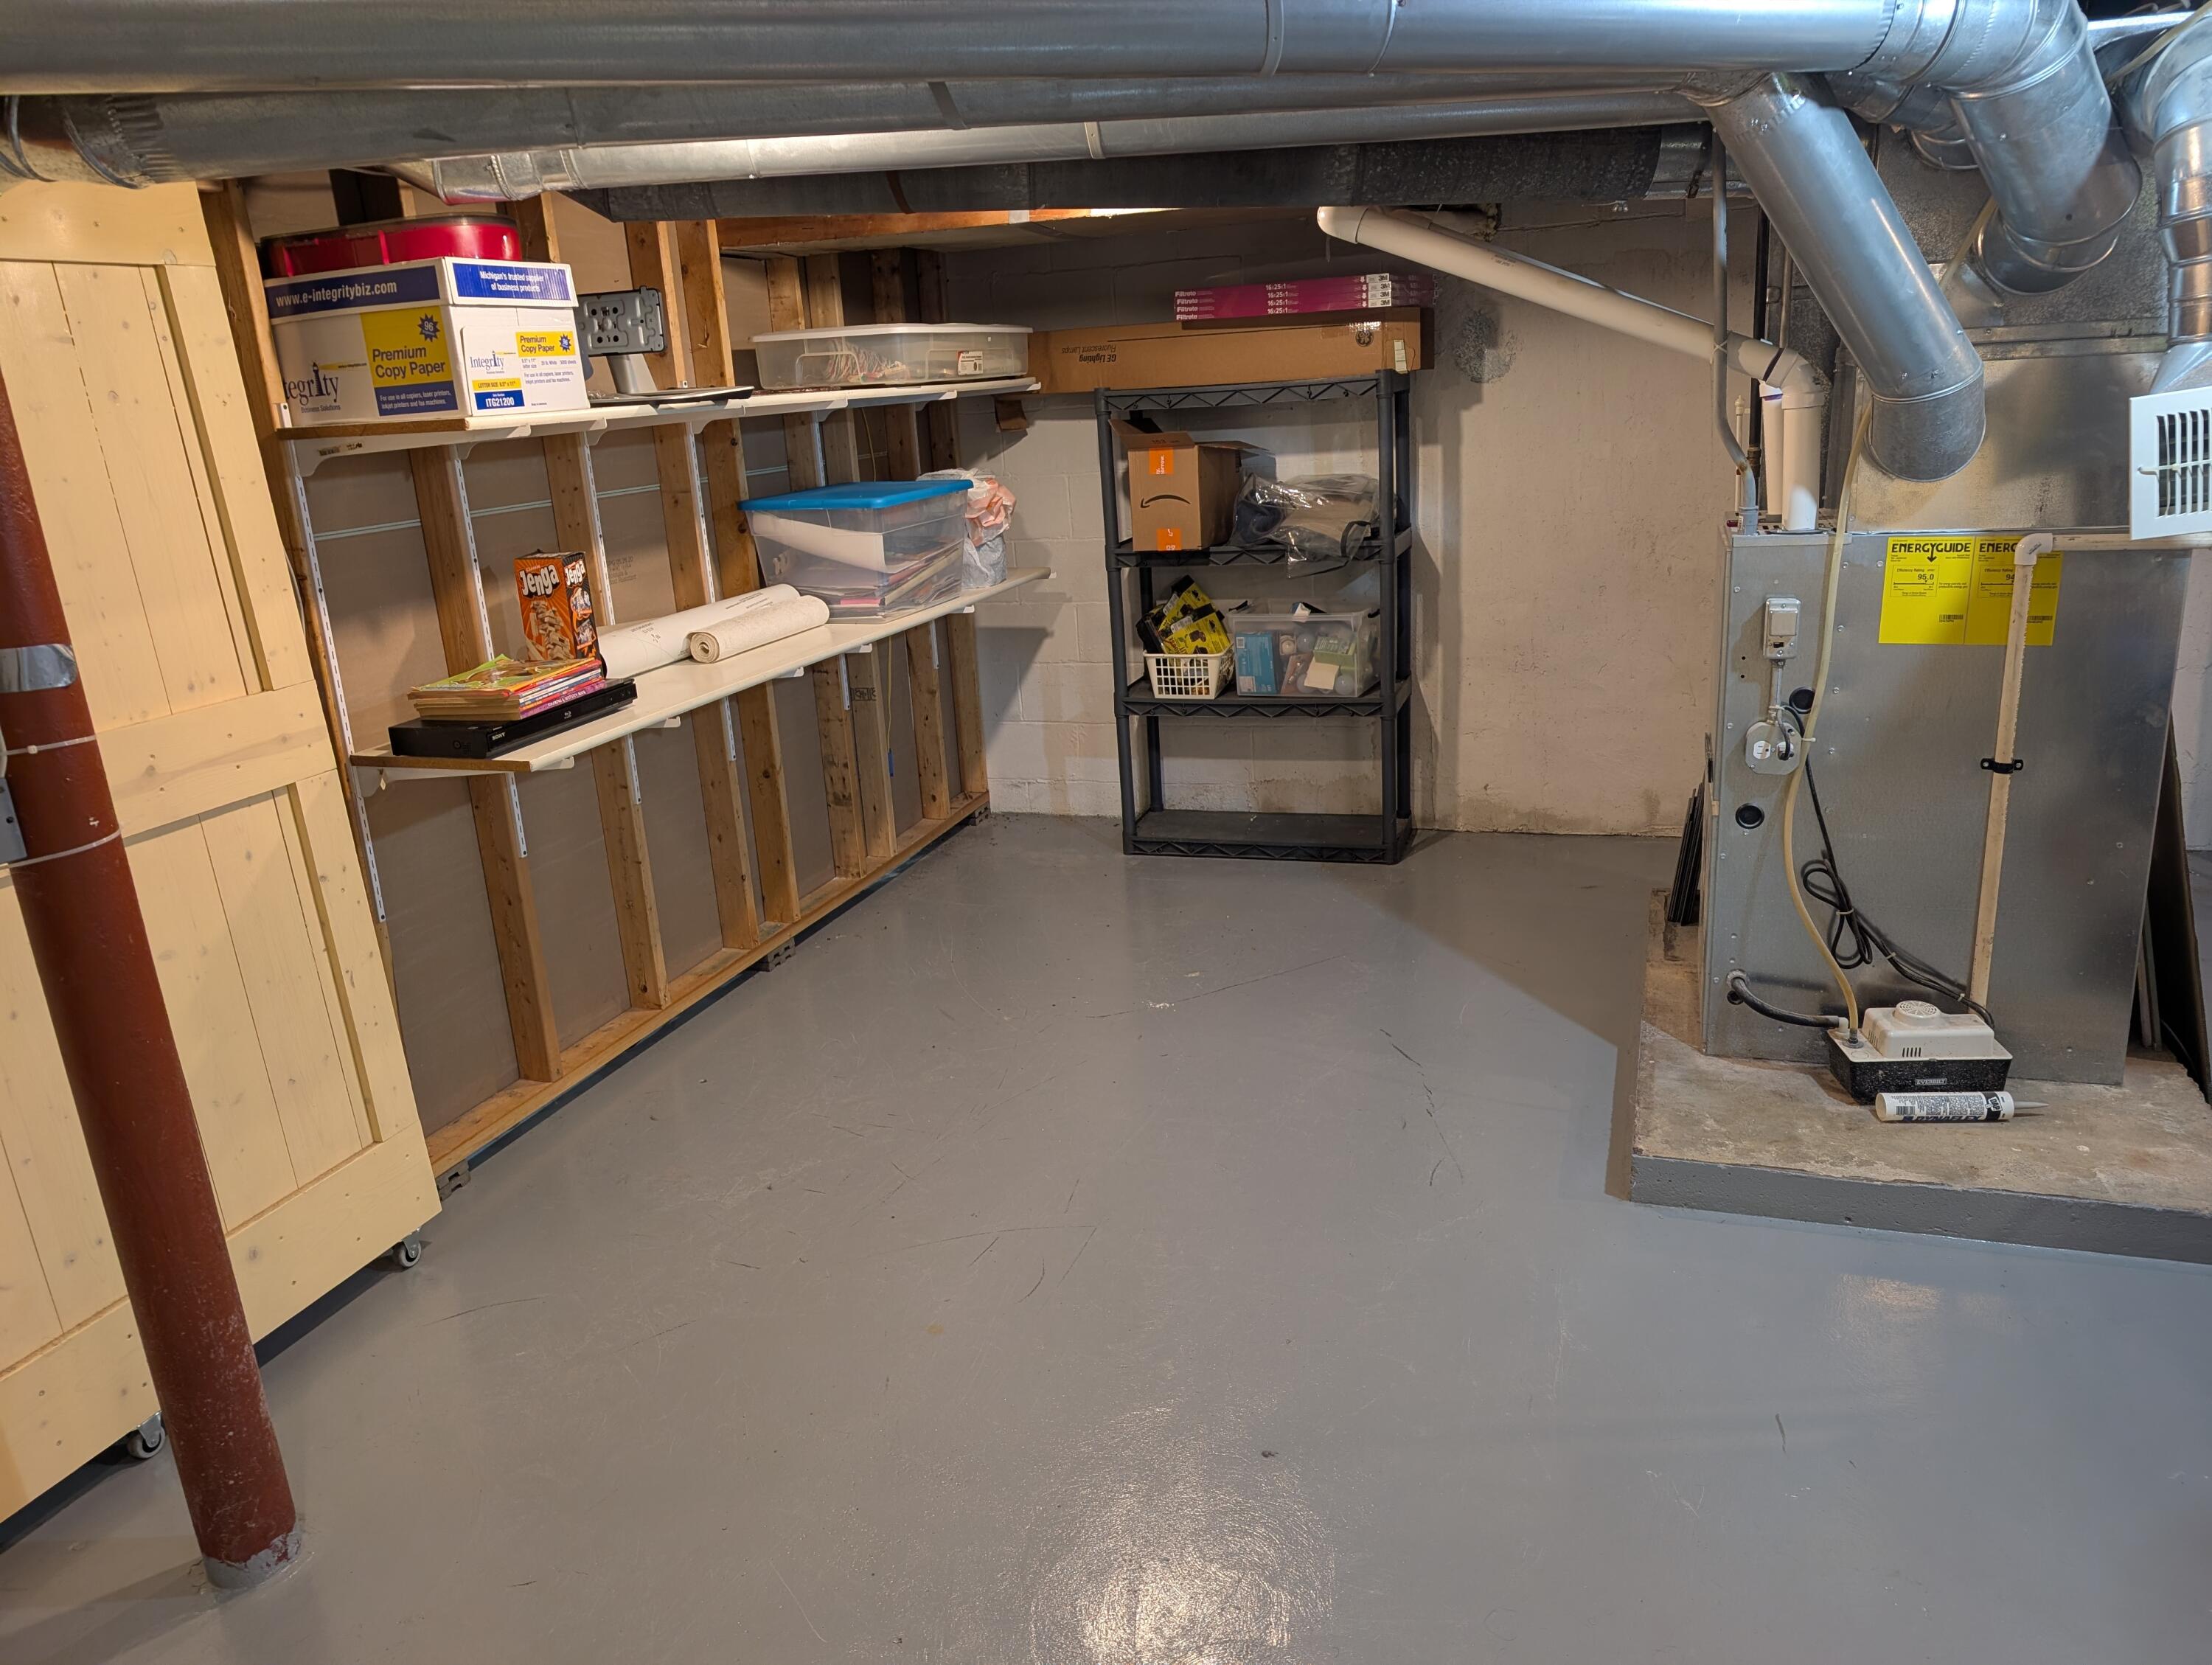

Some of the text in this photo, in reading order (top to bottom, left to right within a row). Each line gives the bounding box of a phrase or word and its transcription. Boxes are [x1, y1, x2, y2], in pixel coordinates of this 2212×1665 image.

[480, 271, 507, 281] Michigan's
[276, 282, 397, 307] www.e-integritybiz.com
[424, 321, 434, 331] 96
[372, 345, 427, 362] Premium
[521, 344, 554, 354] Copy Paper
[1062, 344, 1116, 354] Fluorescent Lamps
[469, 350, 504, 371] Integrity
[1079, 353, 1117, 364] GE Lighting
[375, 361, 446, 380] Copy Paper
[283, 361, 338, 406] tegrity
[485, 397, 515, 407] ITG21200
[1891, 542, 1971, 557] ENERGYGUIDE
[1979, 542, 2017, 553] ENERG
[565, 560, 586, 586] Jenga
[519, 564, 560, 596] Jenga
[492, 732, 505, 741] SONY
[1990, 1099, 2001, 1110] DAP
